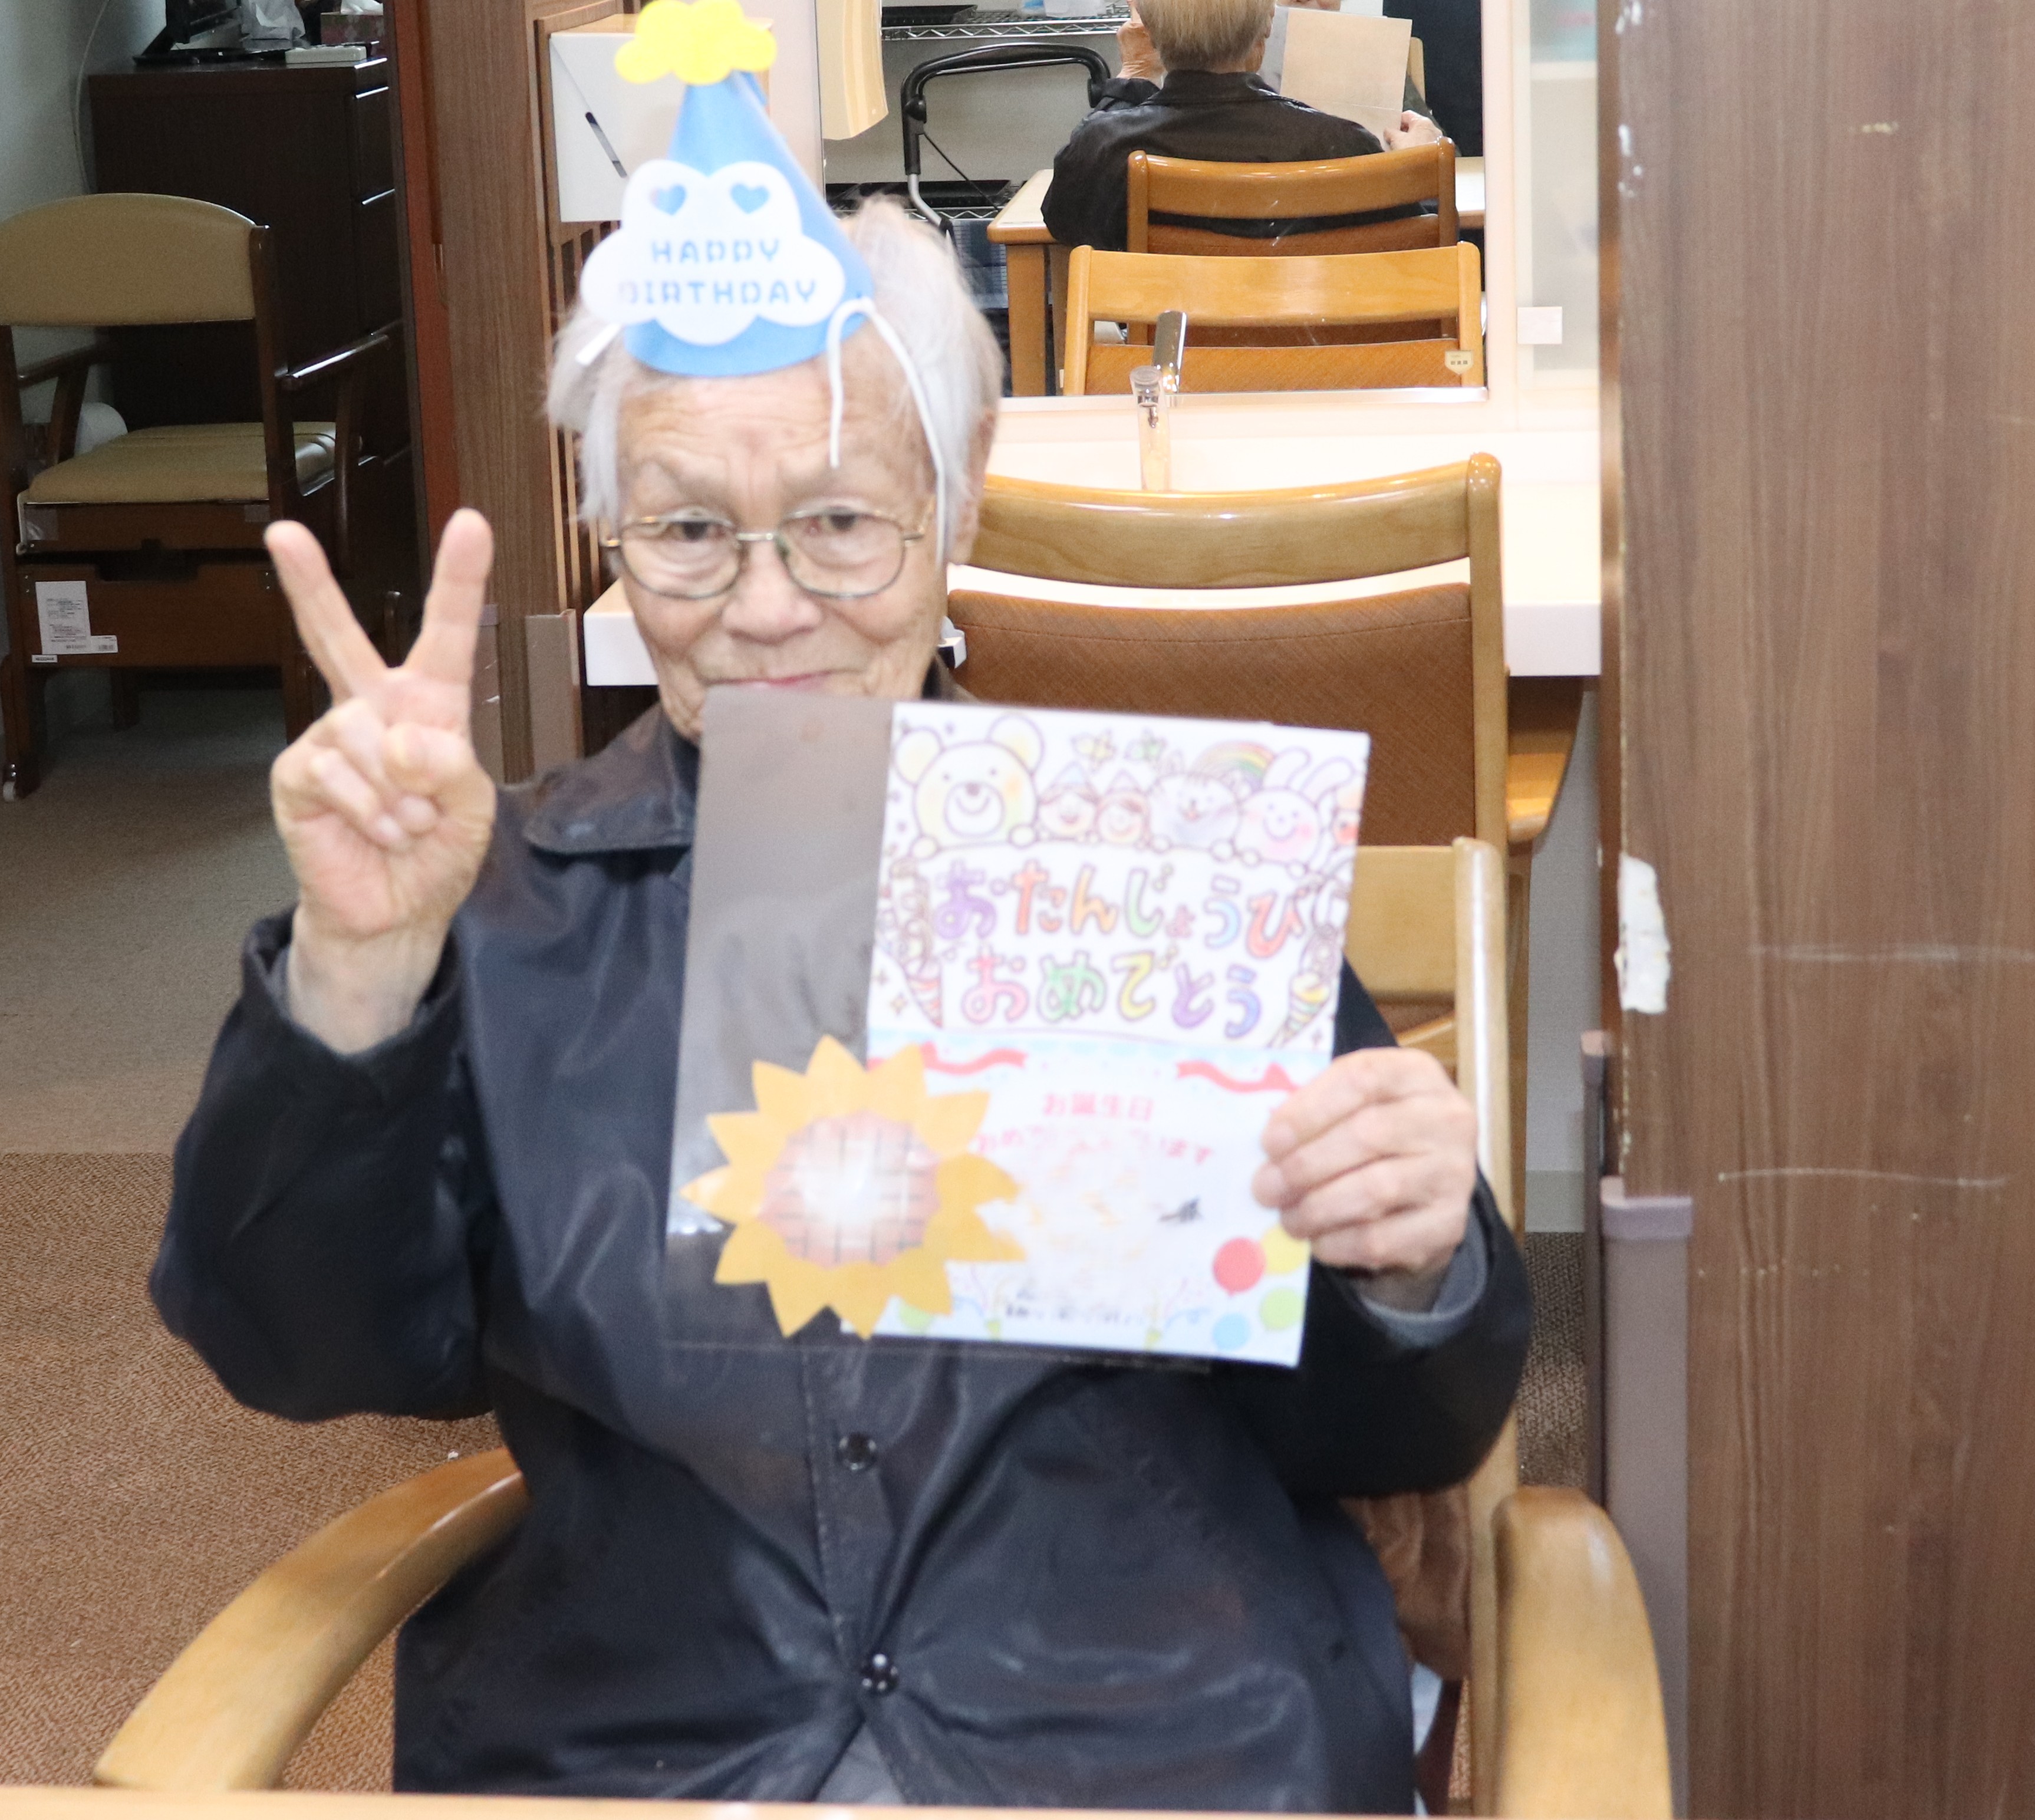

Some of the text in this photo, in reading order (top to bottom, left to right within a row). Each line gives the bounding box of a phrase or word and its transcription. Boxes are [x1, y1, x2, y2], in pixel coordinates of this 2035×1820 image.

[651, 238, 780, 263] HAPPY
[961, 942, 1262, 1039] おめでとう
